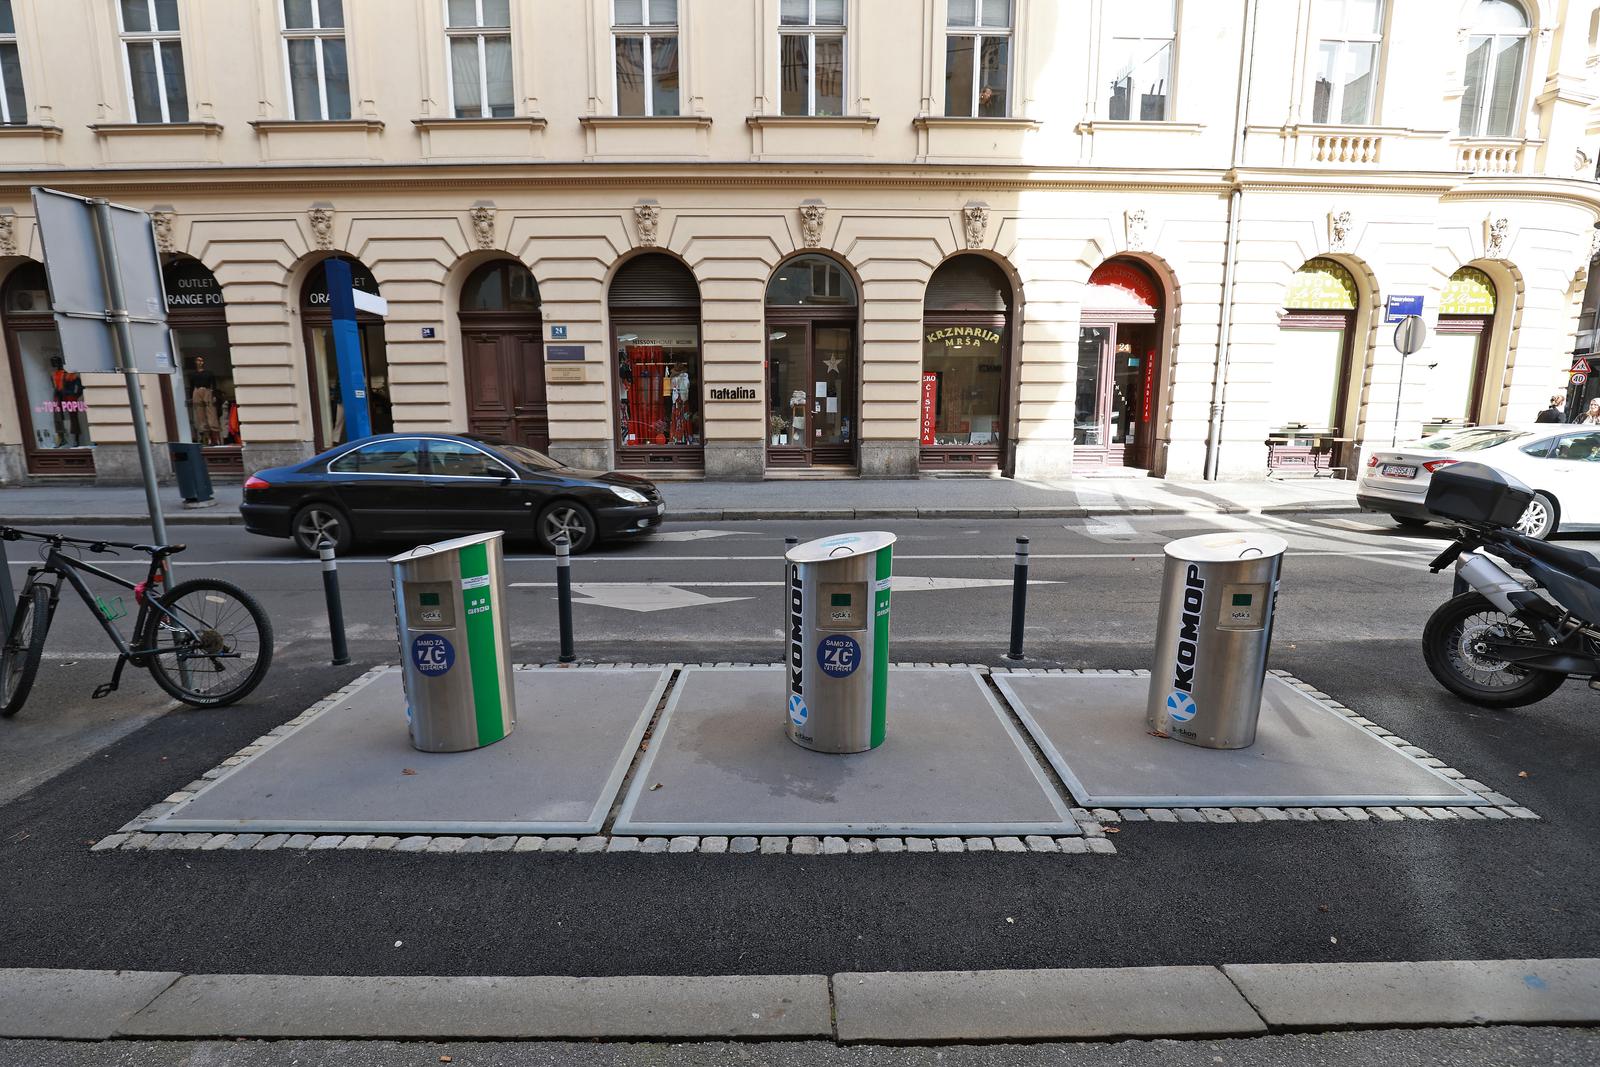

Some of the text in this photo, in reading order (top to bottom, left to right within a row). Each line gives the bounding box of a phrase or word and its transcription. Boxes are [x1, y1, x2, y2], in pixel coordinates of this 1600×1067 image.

[178, 278, 213, 288] OUTLET
[168, 293, 204, 305] RANGE
[205, 293, 223, 304] POI
[926, 326, 1000, 344] KRZNARIJA
[945, 336, 981, 347] MRŠA
[1119, 343, 1130, 351] 24
[710, 386, 756, 399] naftalina
[791, 563, 803, 695] KOMOP
[1173, 563, 1205, 693] KOMOP
[417, 646, 446, 664] ZG
[824, 647, 853, 665] ZG
